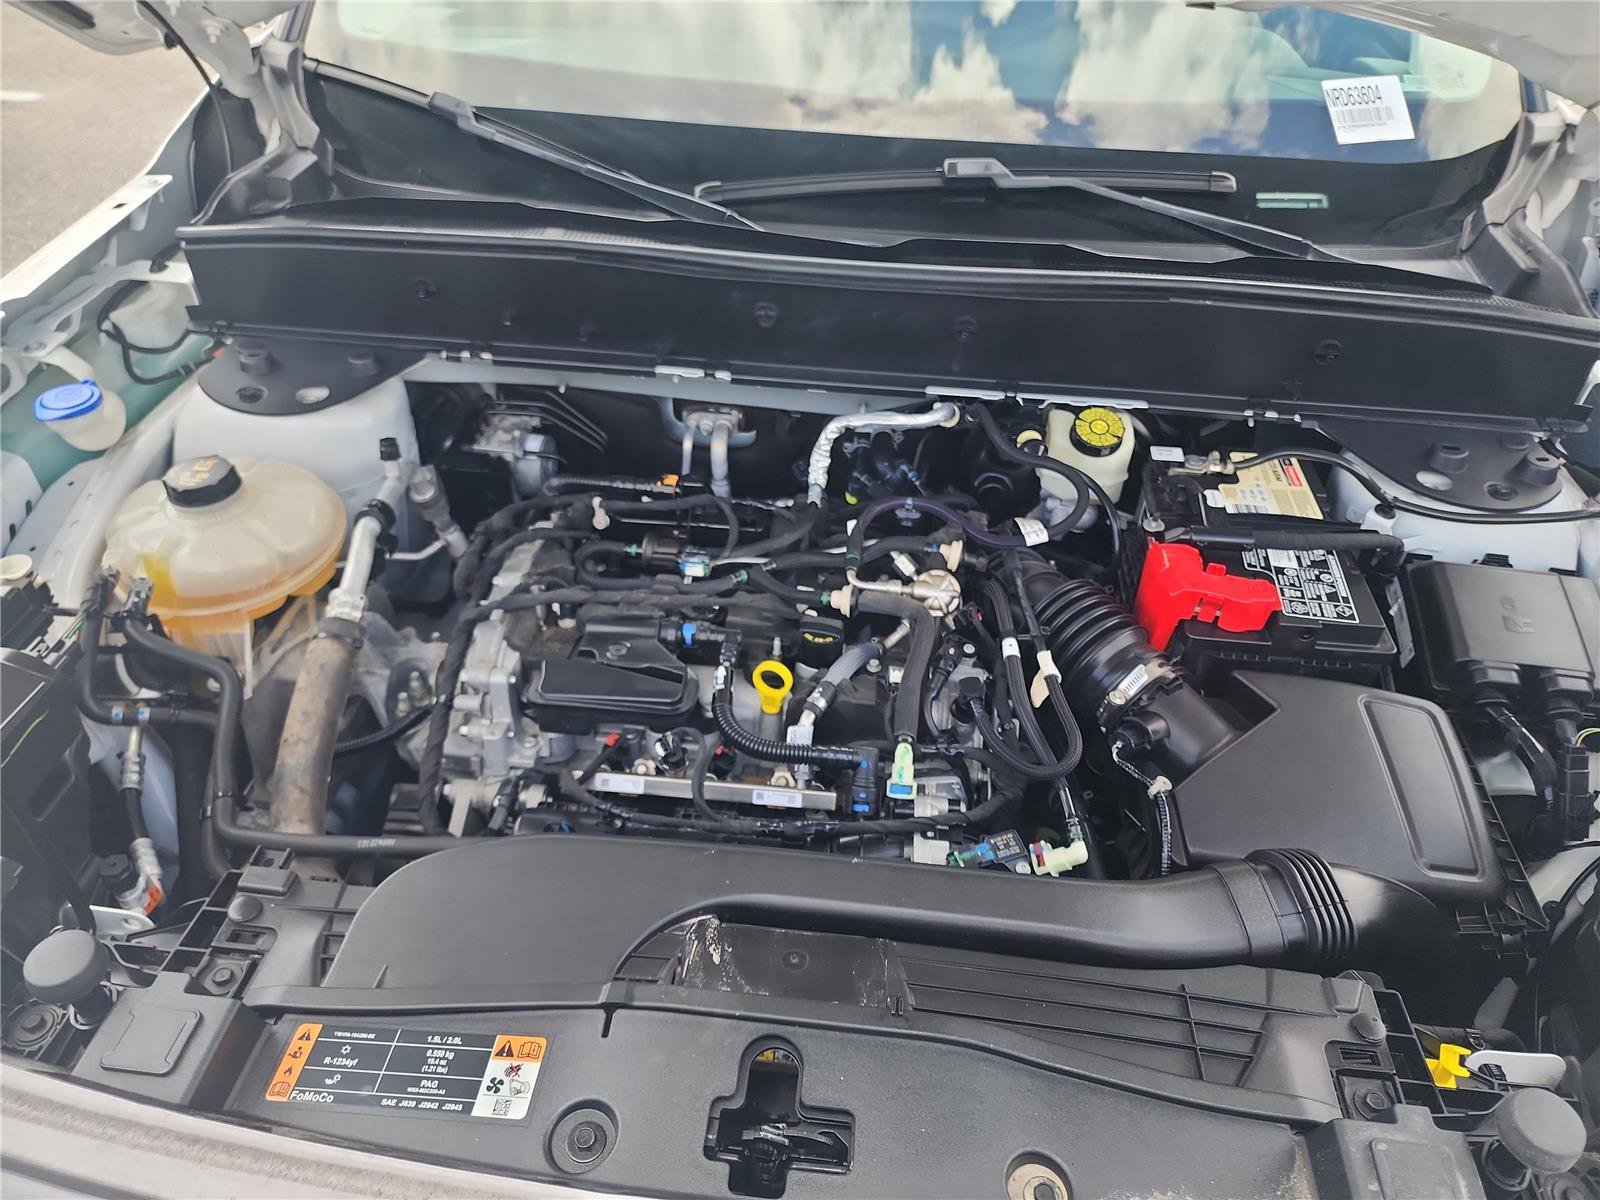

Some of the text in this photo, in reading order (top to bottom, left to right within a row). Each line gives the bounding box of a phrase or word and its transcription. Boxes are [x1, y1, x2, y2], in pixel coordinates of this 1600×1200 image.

[1324, 85, 1383, 108] NRD63604
[427, 1035, 441, 1043] 1.5L
[446, 1037, 463, 1045] 2.0L
[445, 1050, 455, 1060] kg
[323, 1056, 358, 1067] R-1234yf
[420, 1079, 439, 1088] PAG
[289, 1090, 334, 1103] FoMoCo
[381, 1098, 397, 1107] SAE
[399, 1099, 416, 1108] J639
